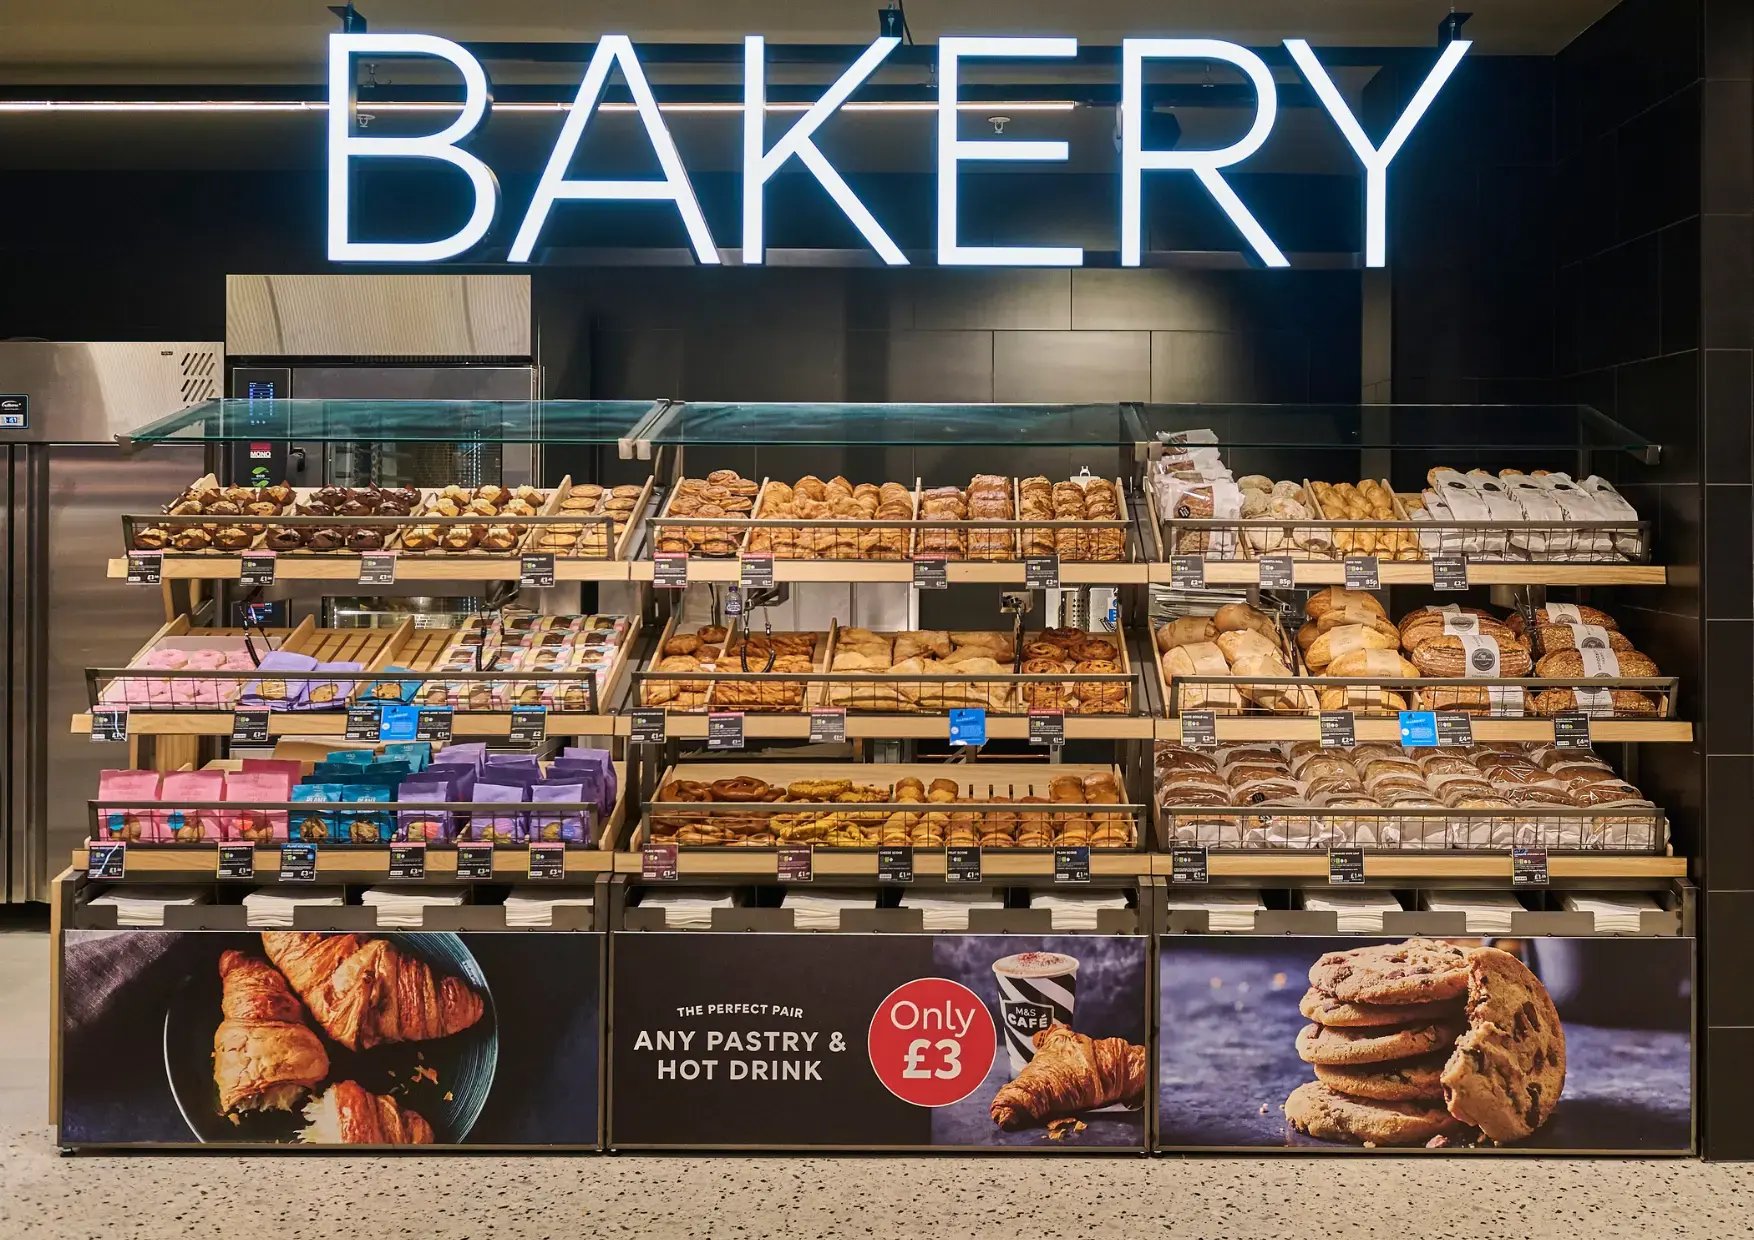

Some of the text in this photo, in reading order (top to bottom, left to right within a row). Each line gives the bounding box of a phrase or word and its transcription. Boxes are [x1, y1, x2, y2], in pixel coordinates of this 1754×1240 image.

[327, 33, 1472, 267] BAKERY
[1279, 578, 1291, 587] 85p
[676, 1003, 804, 1018] THE PERFECT PAIR
[890, 1000, 976, 1038] Only
[1007, 1014, 1048, 1028] CAFÉ
[1015, 1006, 1037, 1016] M&S
[633, 1030, 847, 1052] ANY PASTRY &
[657, 1059, 823, 1081] HOT DRINK
[902, 1038, 962, 1080] £3
